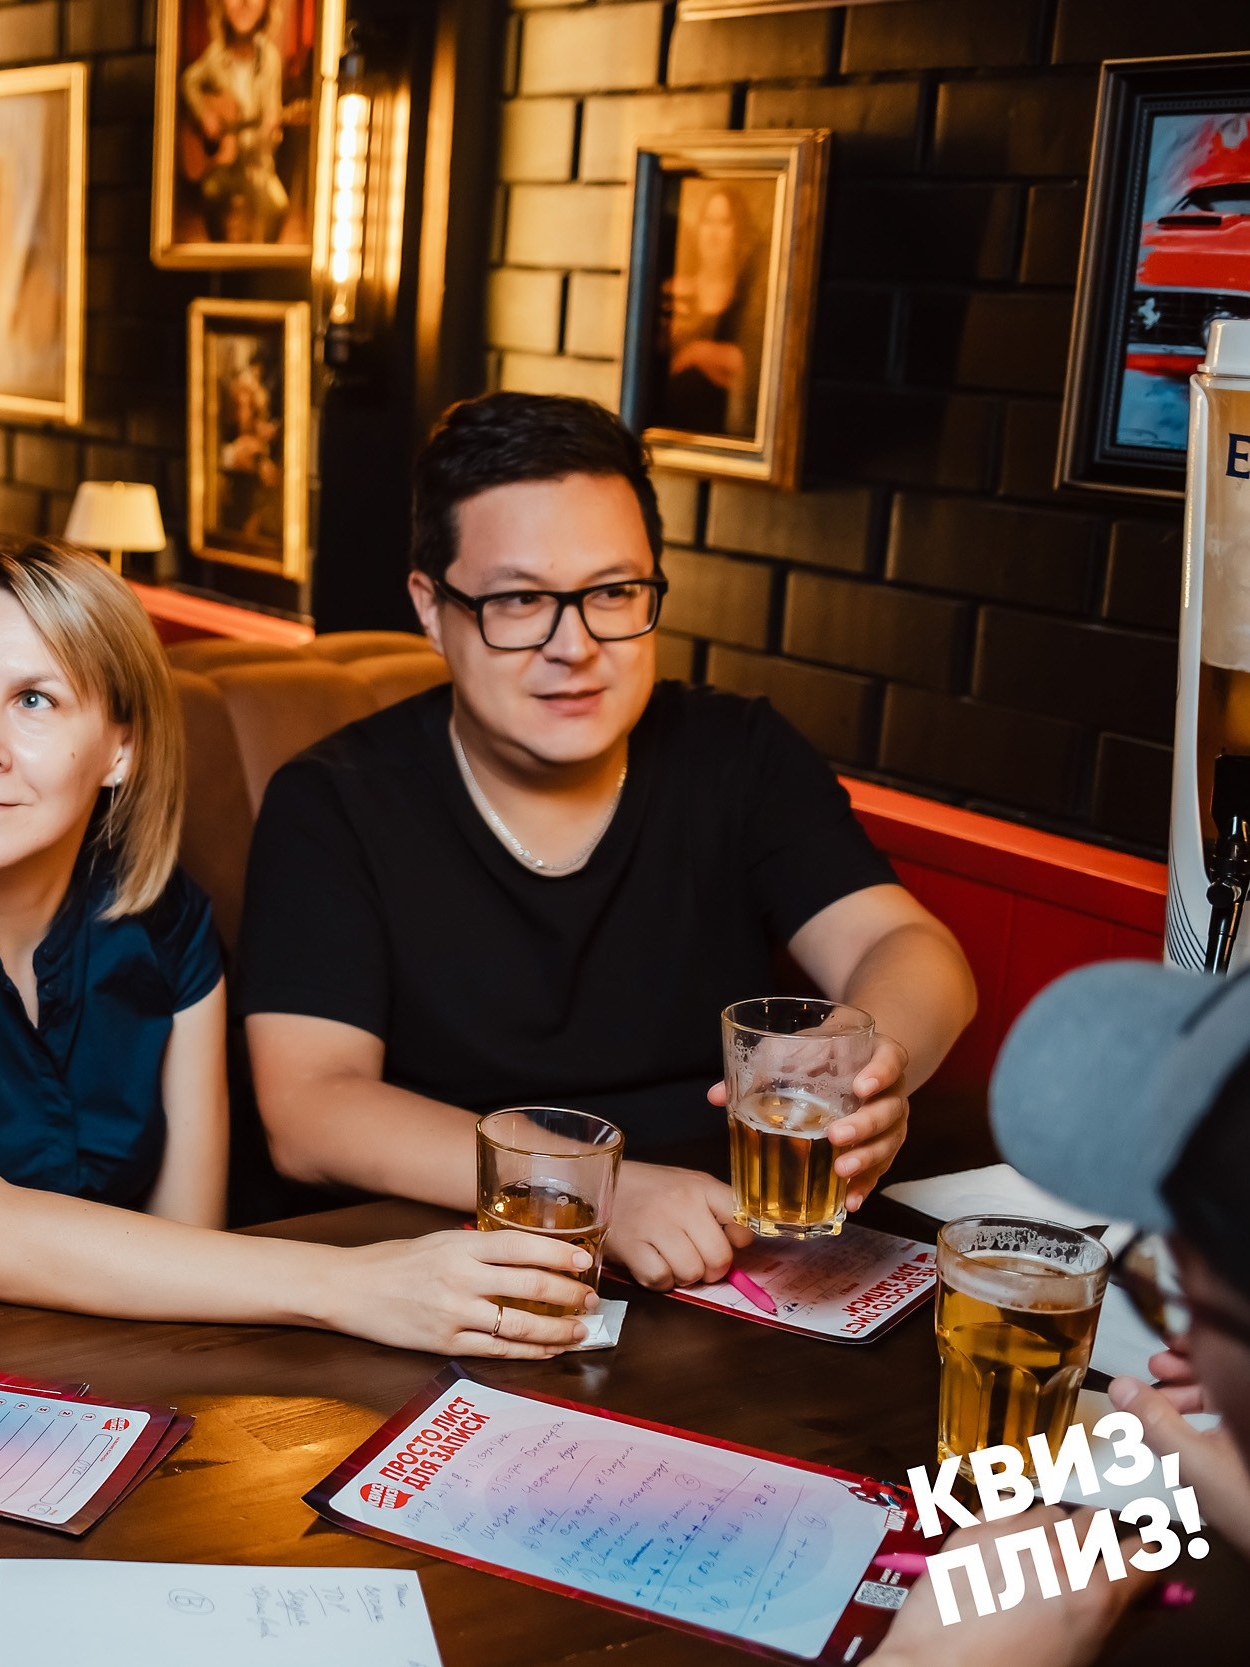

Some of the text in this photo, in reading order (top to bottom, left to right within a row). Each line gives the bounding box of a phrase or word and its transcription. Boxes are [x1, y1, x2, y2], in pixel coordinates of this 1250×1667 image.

[887, 1262, 916, 1286] ДЛЯ
[872, 1277, 928, 1311] ПРОСТО
[840, 1310, 883, 1334] ЛИСТ
[379, 1396, 475, 1482] ПРОСТО ЛИСТ
[402, 1412, 490, 1491] ДЛЯ ЗАПИСИ
